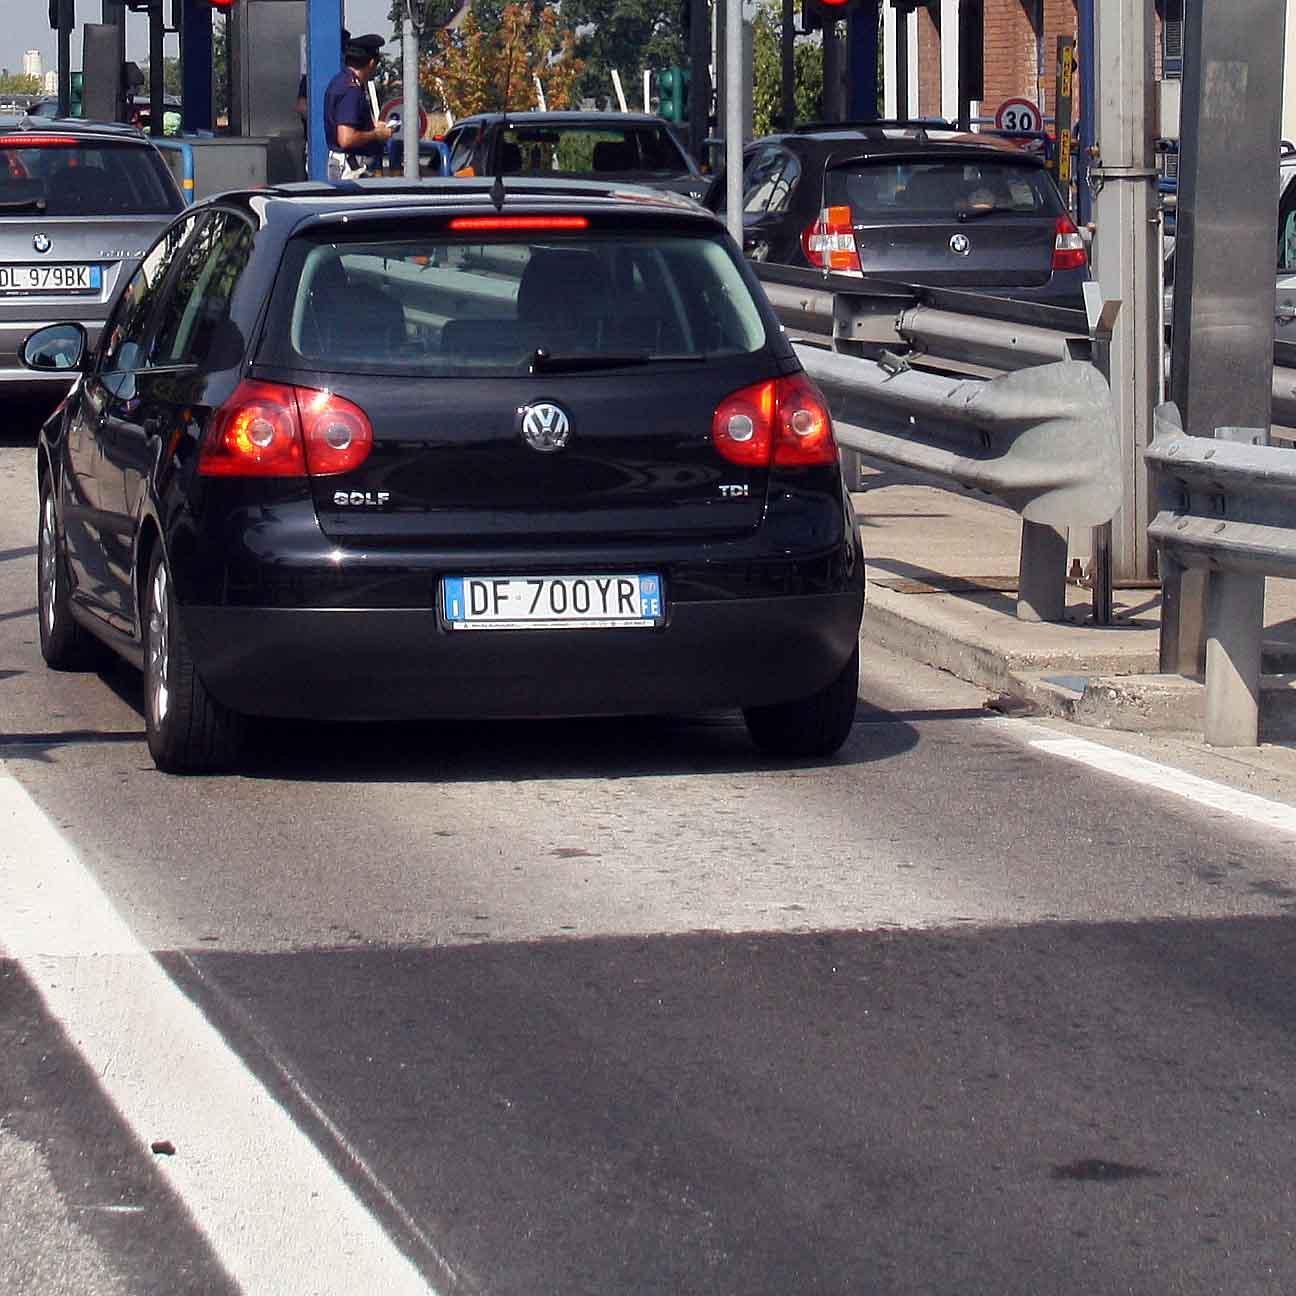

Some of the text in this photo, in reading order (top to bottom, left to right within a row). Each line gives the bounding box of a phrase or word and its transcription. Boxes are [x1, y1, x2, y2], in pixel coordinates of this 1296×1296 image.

[1005, 111, 1032, 131] 30
[29, 267, 87, 287] 979BK
[333, 490, 391, 506] GOLF
[718, 483, 749, 497] TDI
[469, 580, 510, 615] DF
[526, 578, 635, 615] 700YR
